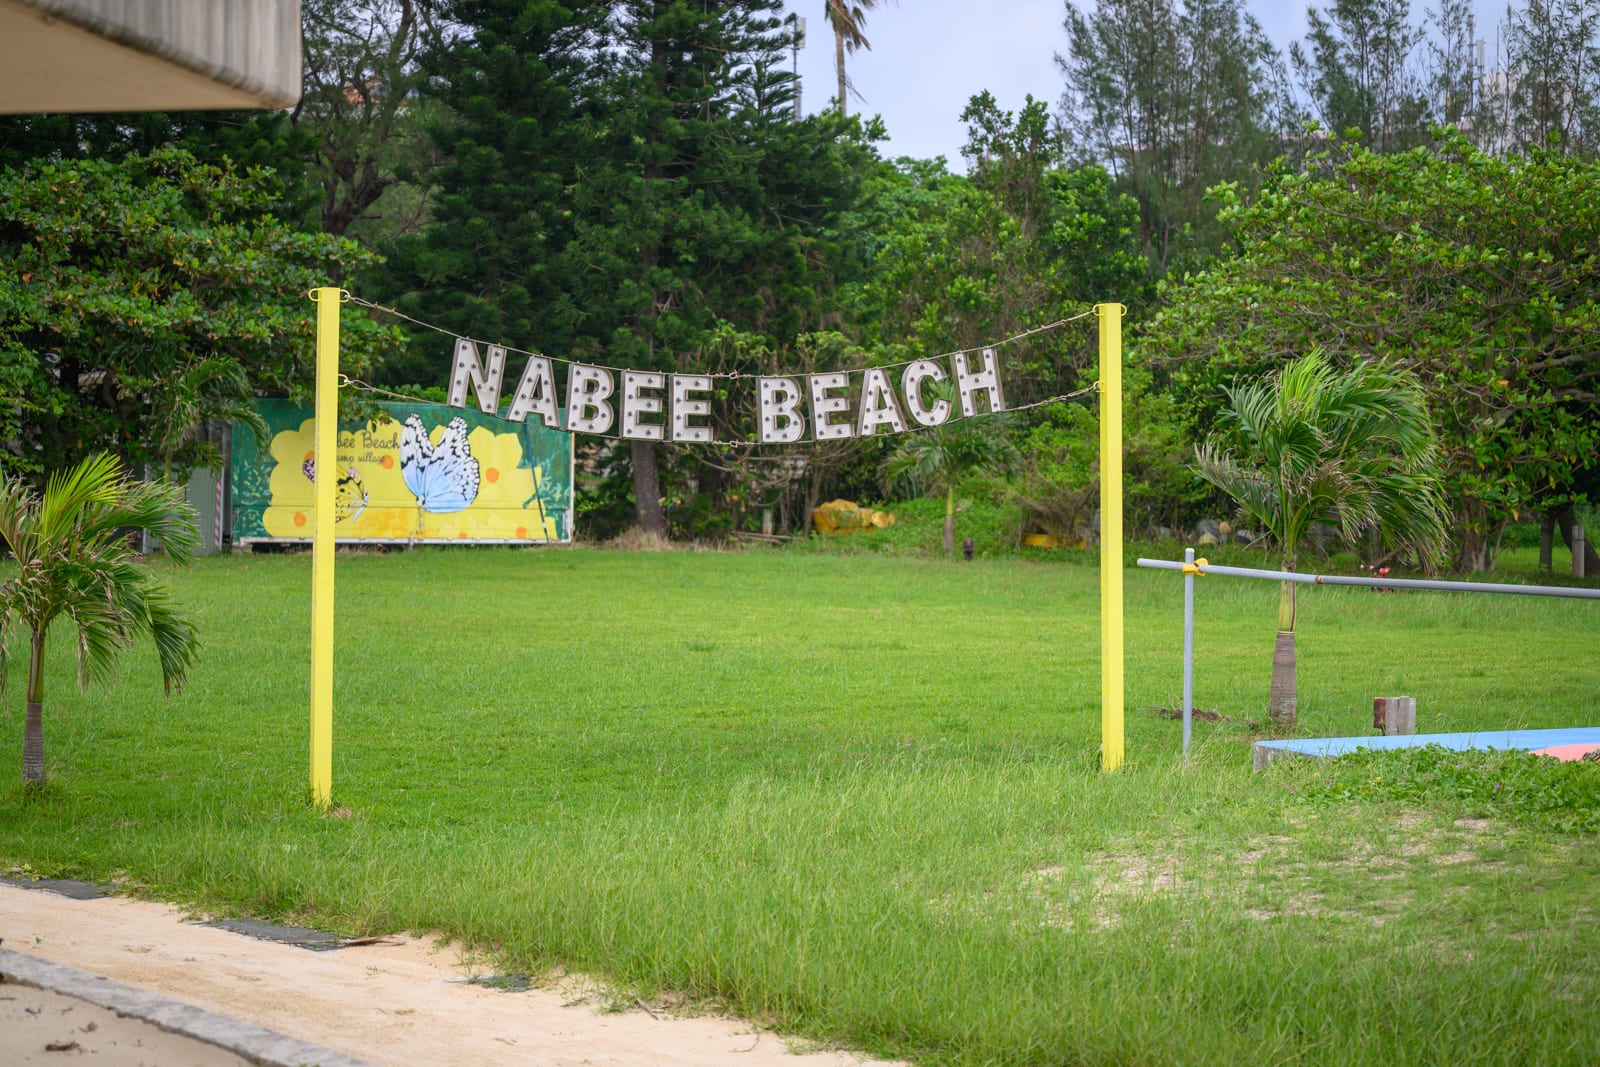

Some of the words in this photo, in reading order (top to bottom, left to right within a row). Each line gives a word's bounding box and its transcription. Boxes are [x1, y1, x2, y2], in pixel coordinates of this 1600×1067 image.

[448, 337, 713, 442] NABEE
[756, 348, 1005, 443] BEACH
[337, 432, 356, 448] bee
[361, 430, 400, 449] Beach
[337, 455, 354, 464] amp
